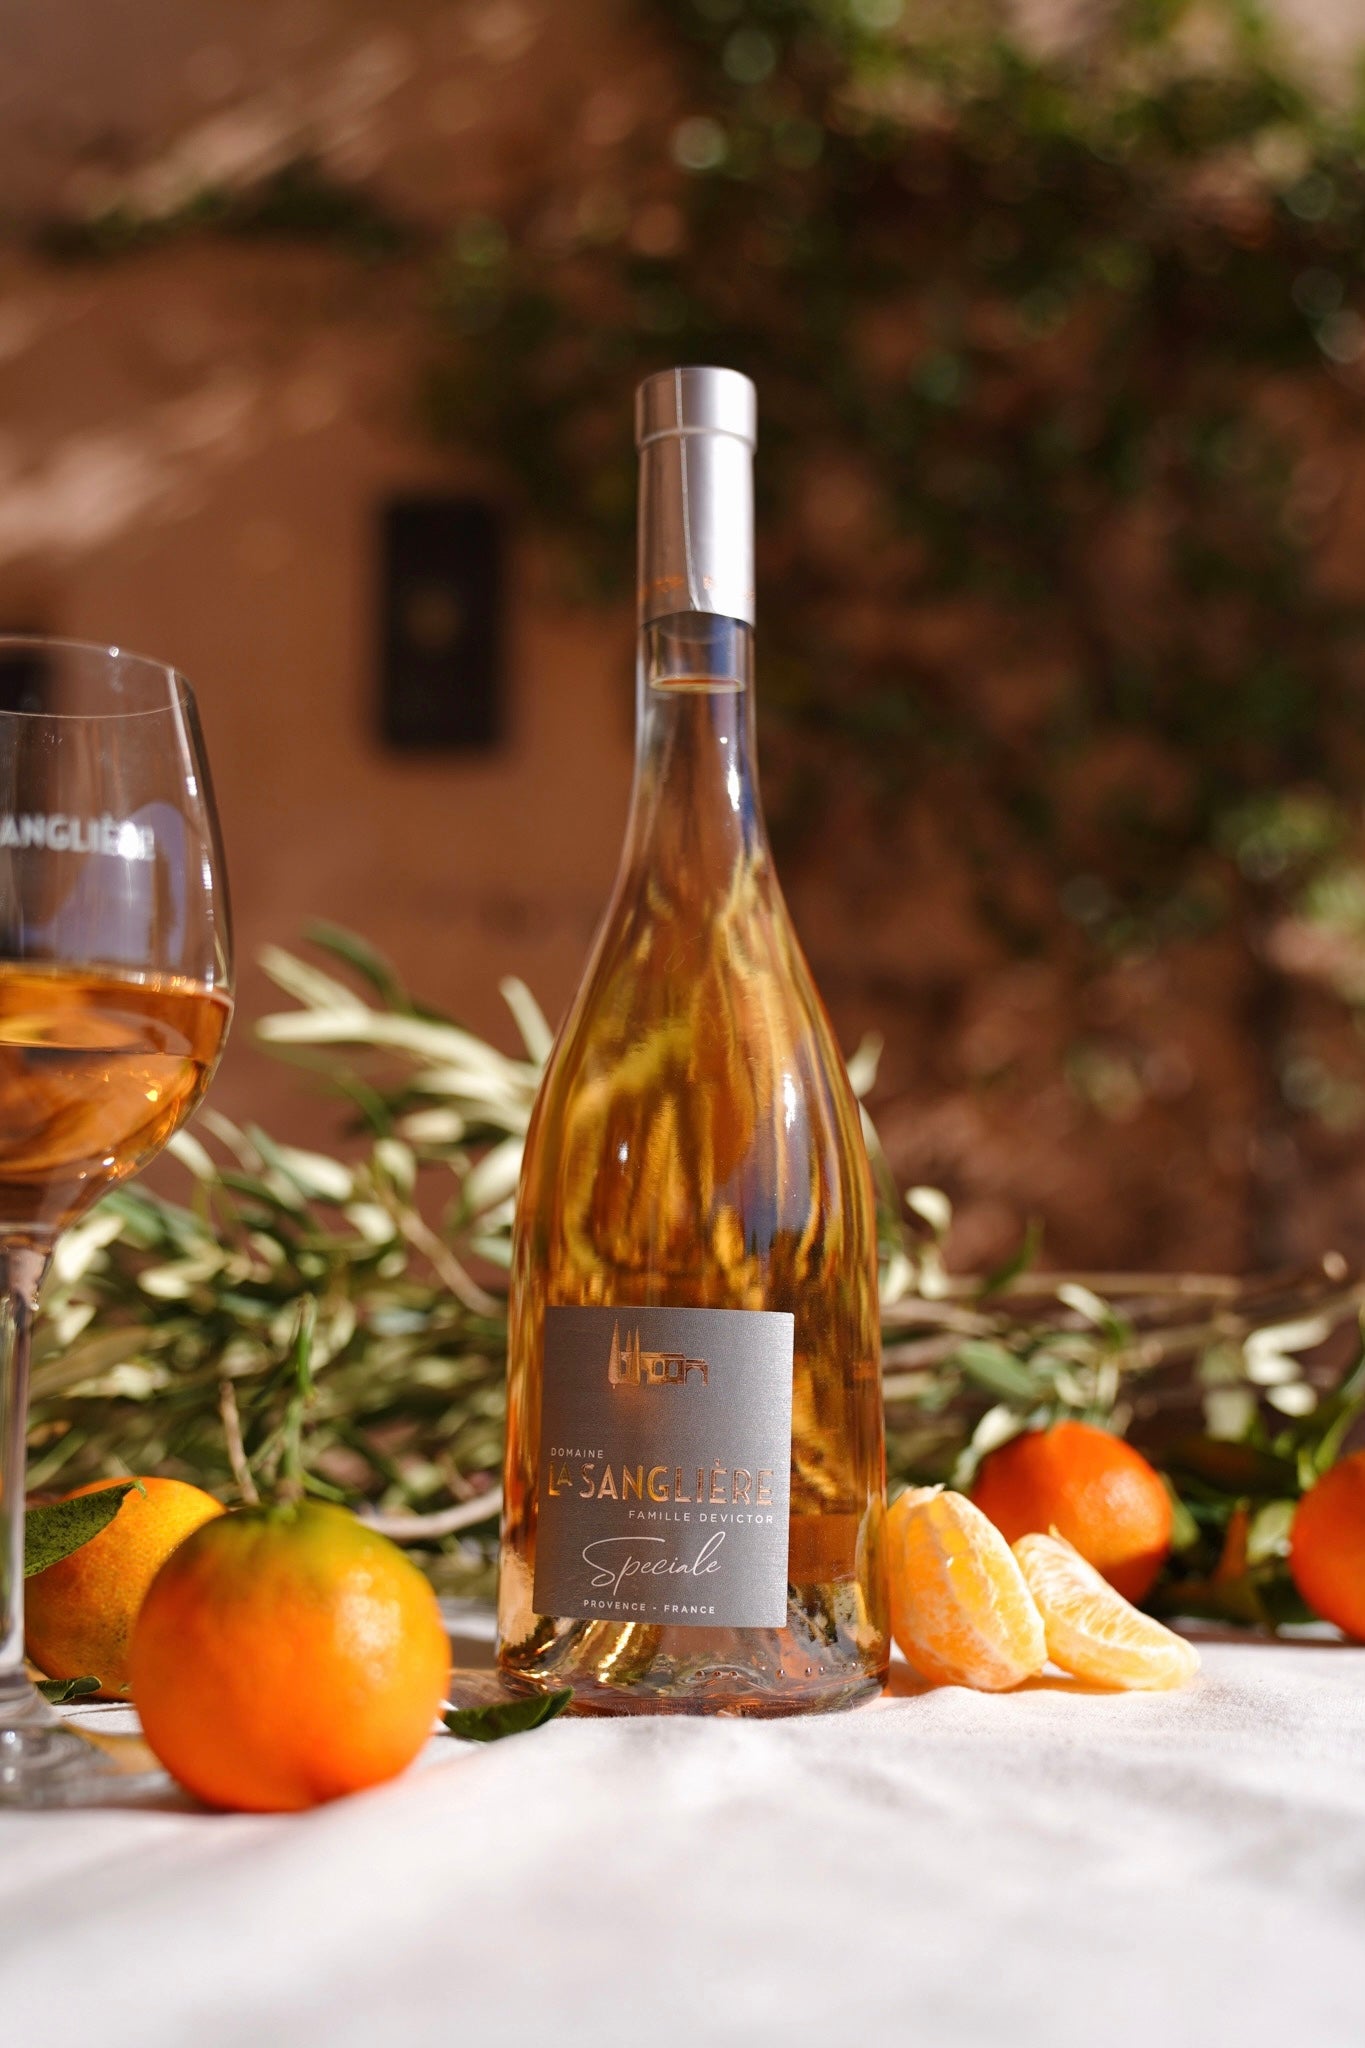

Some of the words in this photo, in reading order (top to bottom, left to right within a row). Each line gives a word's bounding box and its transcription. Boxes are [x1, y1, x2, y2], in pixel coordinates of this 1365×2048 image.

[550, 1447, 604, 1459] DOMAINE
[548, 1461, 573, 1496] LA
[579, 1458, 774, 1505] SANGLIÈRE
[628, 1510, 691, 1522] FAMILLE
[699, 1513, 773, 1524] DEVICTOR
[582, 1531, 726, 1596] Speciale
[583, 1599, 647, 1612] PROVENCE
[663, 1604, 716, 1614] FRANCE
